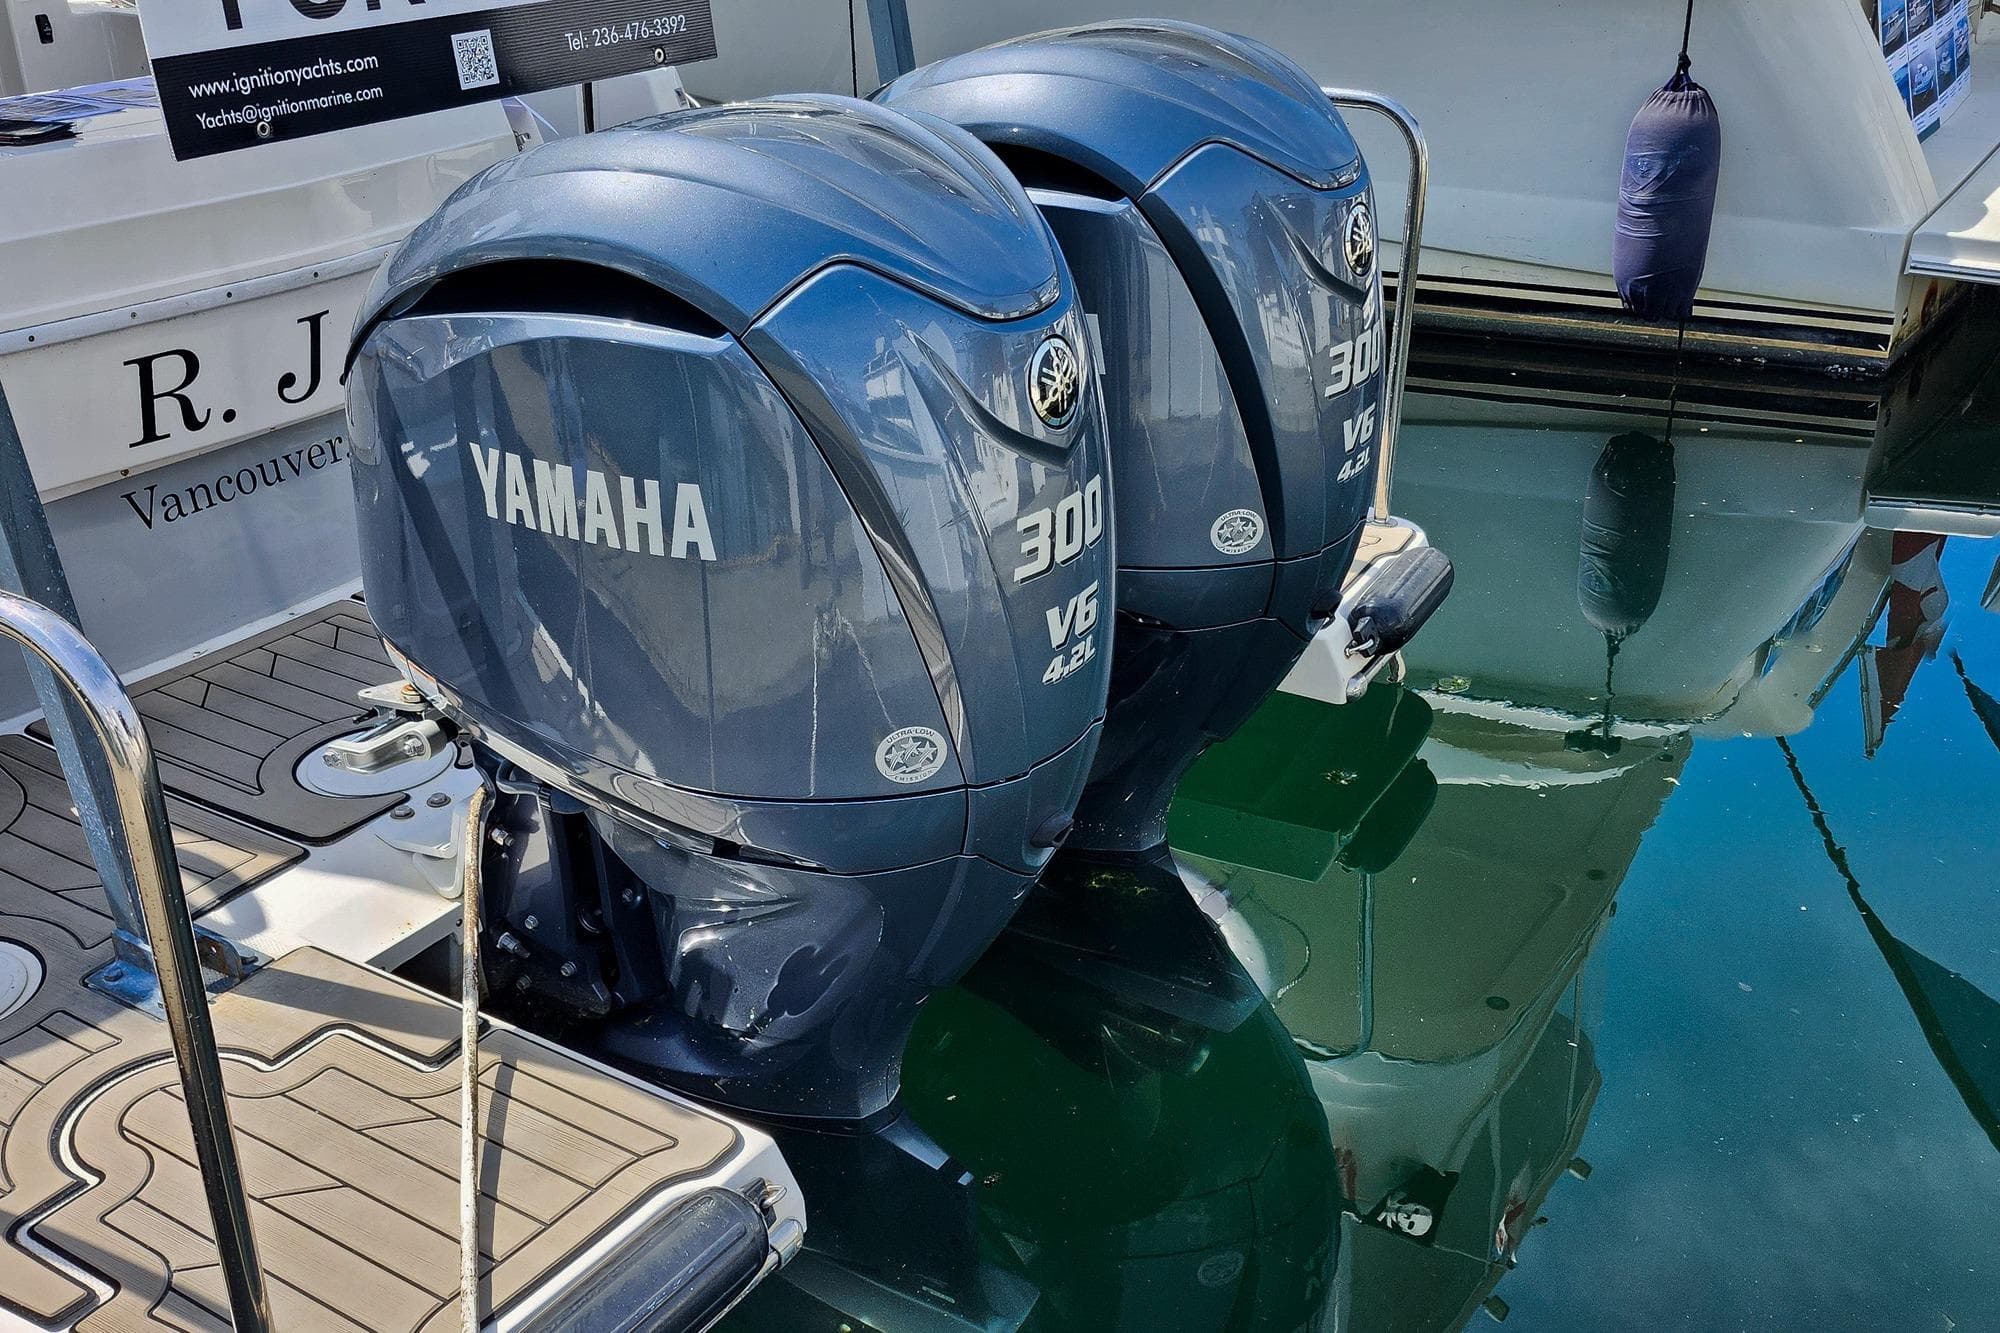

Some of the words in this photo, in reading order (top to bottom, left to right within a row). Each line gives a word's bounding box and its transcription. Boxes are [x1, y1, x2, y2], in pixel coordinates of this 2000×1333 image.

[564, 30, 588, 51] Tel:
[592, 14, 687, 47] 236-476-3392
[188, 53, 379, 99] www.ignitionyachts.com
[195, 84, 384, 130] Yachts@ignitionmarine.com
[1325, 319, 1382, 399] 300
[123, 348, 237, 449] R.
[1343, 402, 1376, 454] V6
[469, 442, 717, 561] YAMAHA
[1013, 474, 1103, 586] 300
[1045, 579, 1100, 652] V6
[1041, 634, 1097, 685] 4.2L
